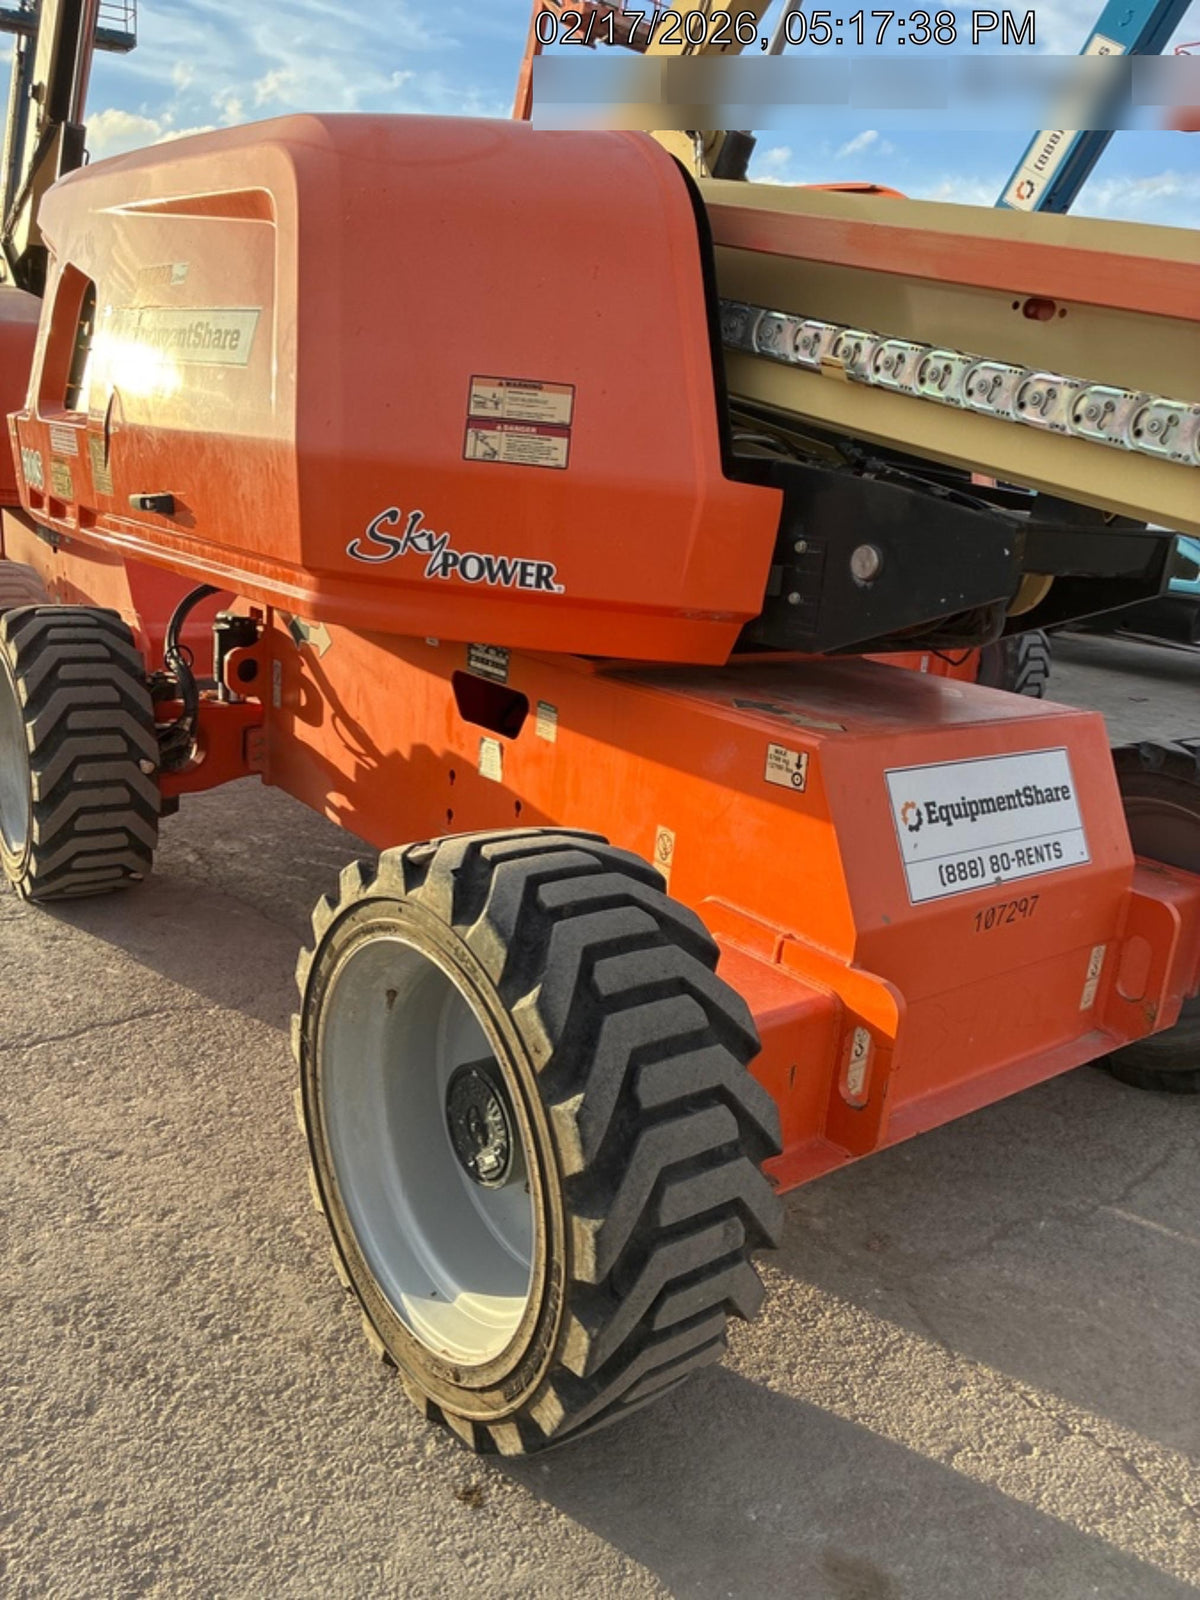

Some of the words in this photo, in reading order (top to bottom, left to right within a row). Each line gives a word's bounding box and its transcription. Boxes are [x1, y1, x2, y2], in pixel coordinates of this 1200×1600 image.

[924, 784, 1072, 827] EquipmentShare
[938, 856, 985, 886] (888)
[989, 841, 1063, 874] 80-RENTS
[975, 895, 1040, 932] 107297
